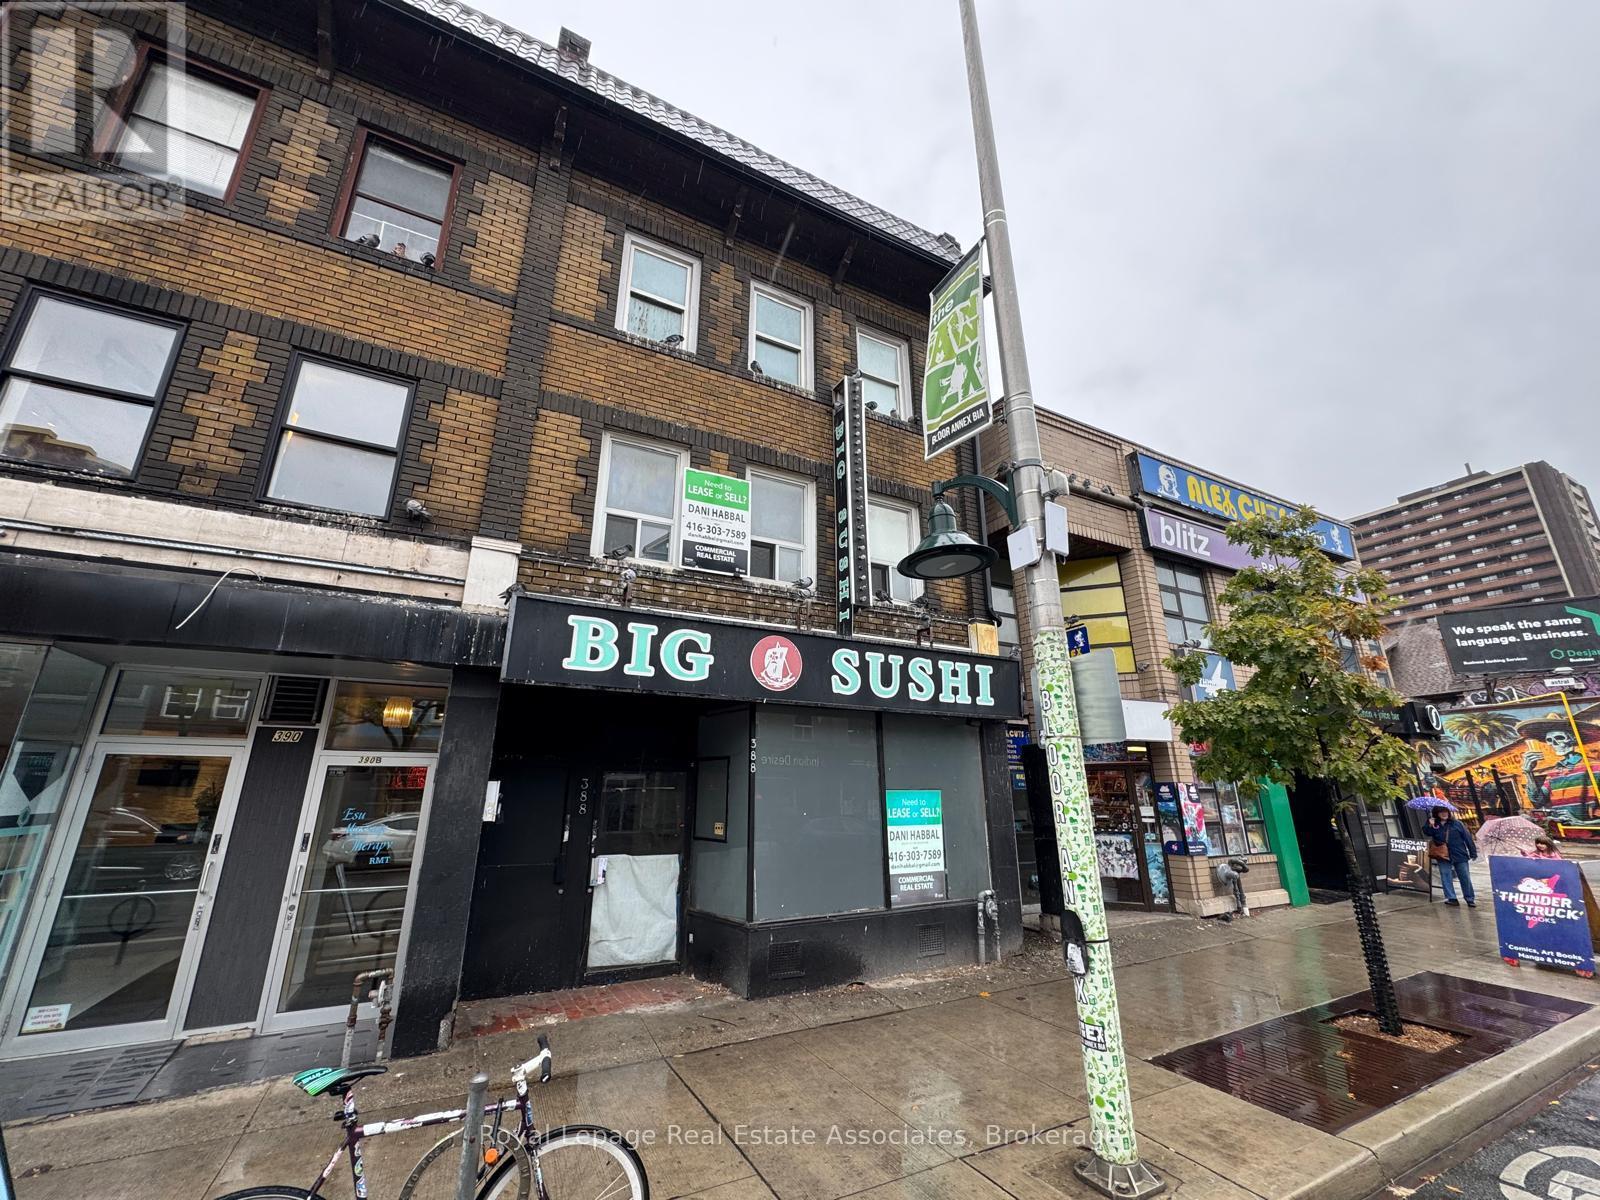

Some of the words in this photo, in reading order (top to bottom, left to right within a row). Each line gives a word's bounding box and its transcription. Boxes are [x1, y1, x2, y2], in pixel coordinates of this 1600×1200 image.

[932, 298, 954, 327] the
[951, 413, 972, 437] ANNEX
[973, 408, 985, 422] BIA
[835, 420, 846, 480] BIG
[704, 479, 723, 490] Need
[688, 484, 714, 498] LEASE
[725, 492, 747, 505] SELL?
[688, 503, 710, 516] DANI
[711, 508, 746, 523] HABBAL
[686, 521, 746, 540] 416-303-7589
[1159, 516, 1211, 557] blitz
[695, 544, 737, 557] COMMERCIAL
[696, 552, 713, 560] REAL
[713, 554, 735, 563] ESTATE
[838, 507, 850, 623] SUSHI
[1452, 626, 1474, 635] We
[1476, 622, 1516, 634] speak
[1518, 620, 1542, 629] the
[1544, 617, 1582, 627] same
[1455, 635, 1520, 648] language.
[1522, 629, 1589, 642] Business.
[562, 614, 715, 683] BIG
[831, 648, 995, 707] SUSHI
[273, 731, 302, 743] 390
[357, 756, 382, 764] 390B
[749, 738, 757, 774] 388
[1041, 689, 1066, 824] BLOOR
[578, 777, 589, 815] 388
[901, 798, 918, 806] Need
[888, 807, 911, 818] LEASE
[920, 807, 940, 818] SELL?
[889, 830, 909, 841] DANI
[910, 829, 940, 841] HABBAL
[1390, 838, 1428, 847] CHOCOLATE
[889, 849, 941, 862] 416-303-7589
[1390, 843, 1428, 852] THERAPY
[369, 856, 391, 865] RMT
[898, 875, 935, 884] COMMERCIAL
[899, 884, 914, 892] REAL
[914, 882, 934, 891] ESTATE
[1499, 891, 1573, 909] THUNDER
[1515, 904, 1581, 921] STRUCK
[1525, 915, 1557, 924] BOOKS
[1508, 944, 1540, 955] Comics,
[1541, 949, 1554, 957] Art
[1556, 952, 1585, 962] Books,
[1518, 952, 1545, 962] Manga
[1554, 959, 1576, 967] More
